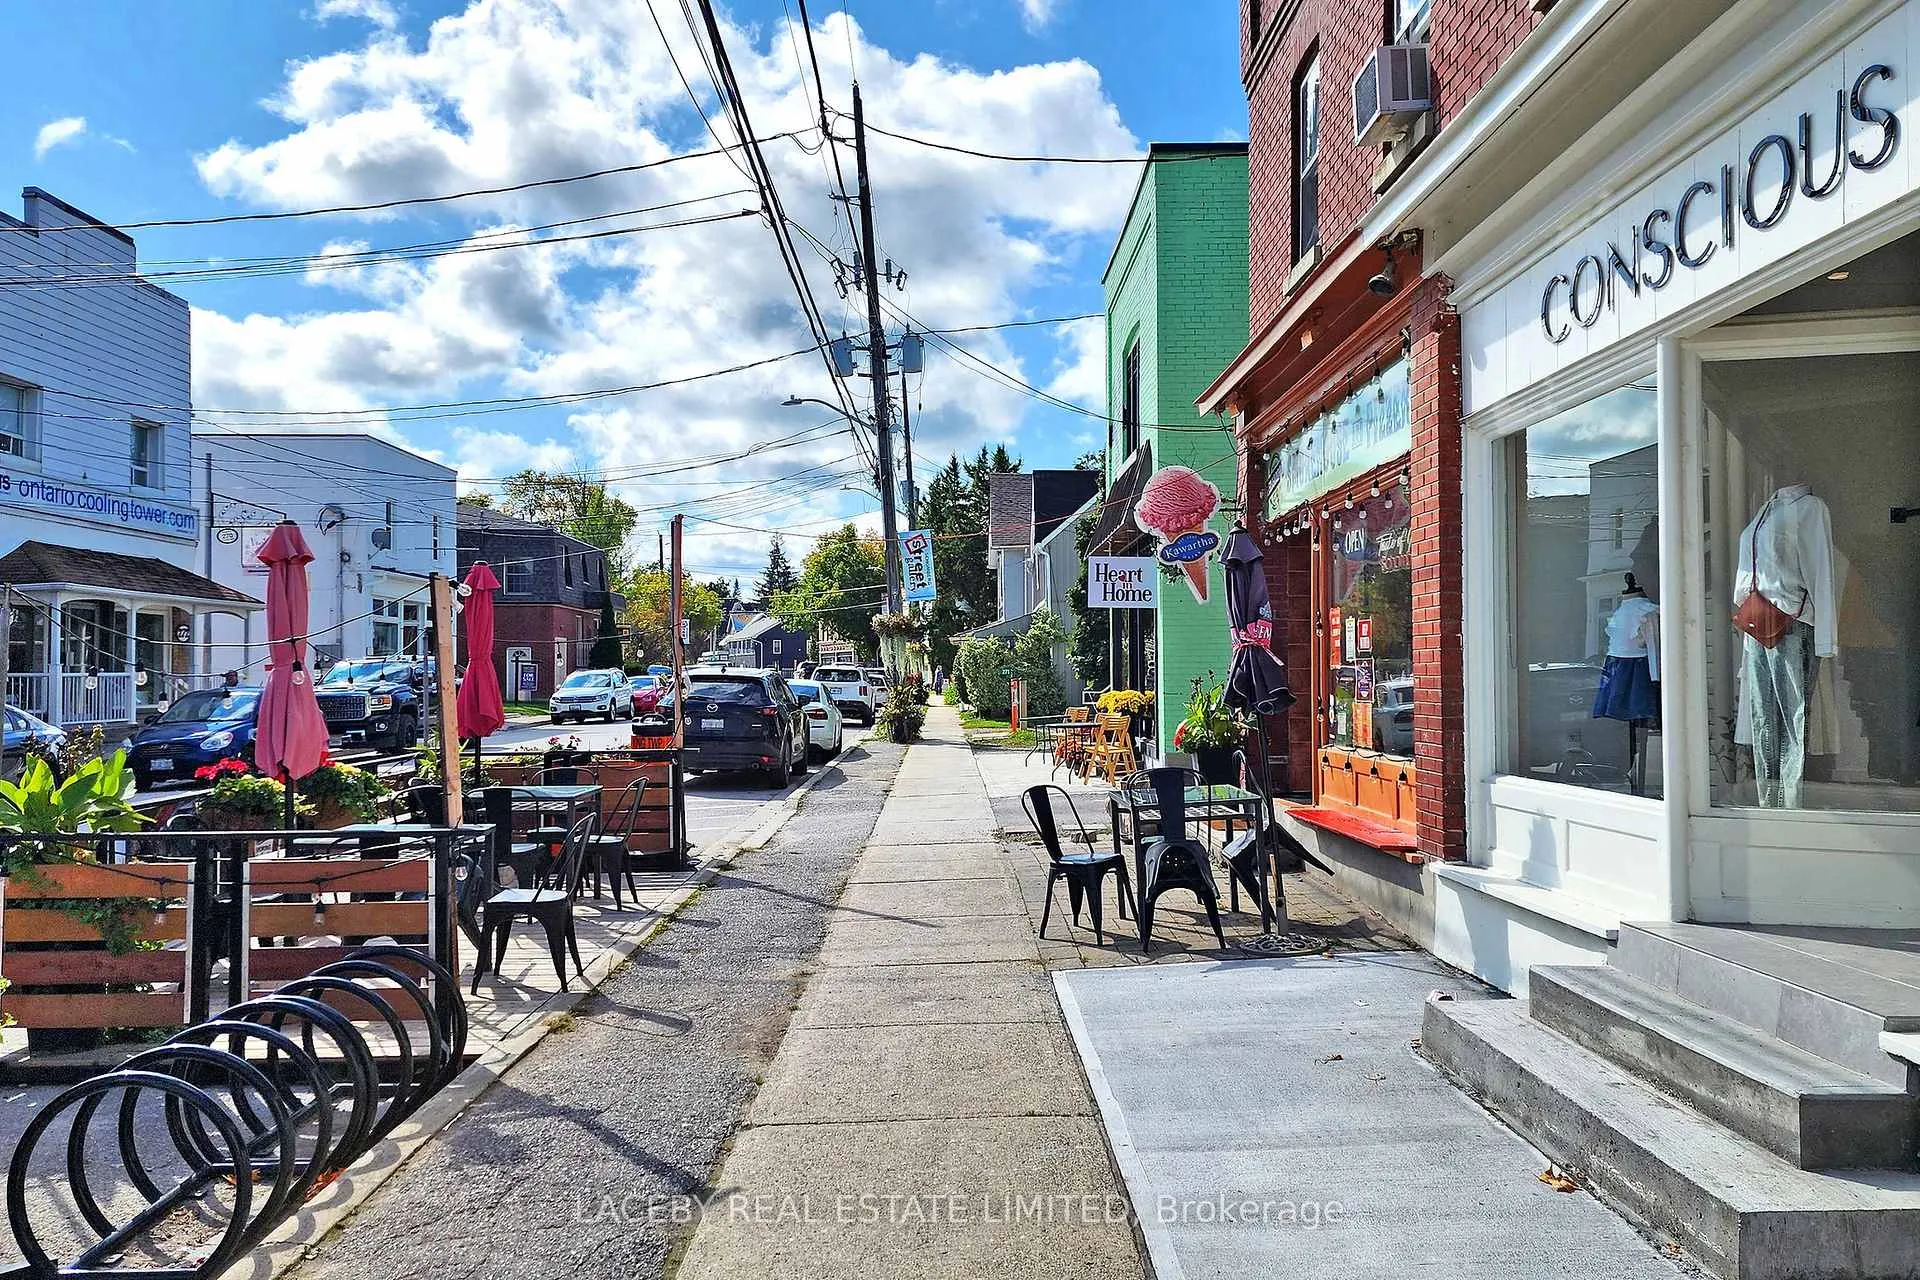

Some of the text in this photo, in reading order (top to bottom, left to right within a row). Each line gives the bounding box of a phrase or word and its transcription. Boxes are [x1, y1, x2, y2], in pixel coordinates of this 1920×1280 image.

[1540, 63, 1898, 344] CONSCIOUS
[1165, 536, 1214, 559] Kawartha
[1345, 528, 1365, 553] OPEN
[905, 557, 917, 593] gallery
[912, 540, 928, 589] street
[1095, 563, 1143, 582] Heart
[1103, 582, 1152, 602] Home
